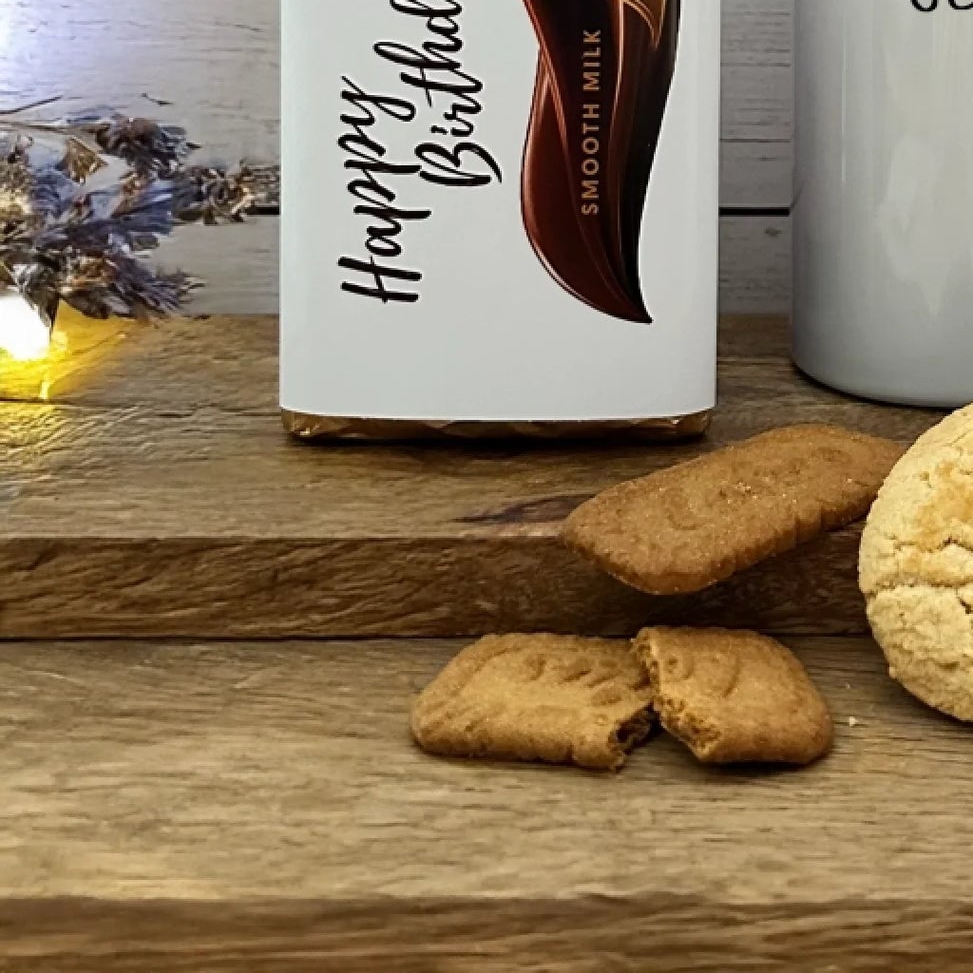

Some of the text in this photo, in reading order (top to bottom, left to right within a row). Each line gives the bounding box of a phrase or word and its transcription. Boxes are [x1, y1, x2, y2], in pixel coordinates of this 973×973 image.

[338, 75, 432, 303] Happy
[582, 29, 601, 215] SMOOTH MILK
